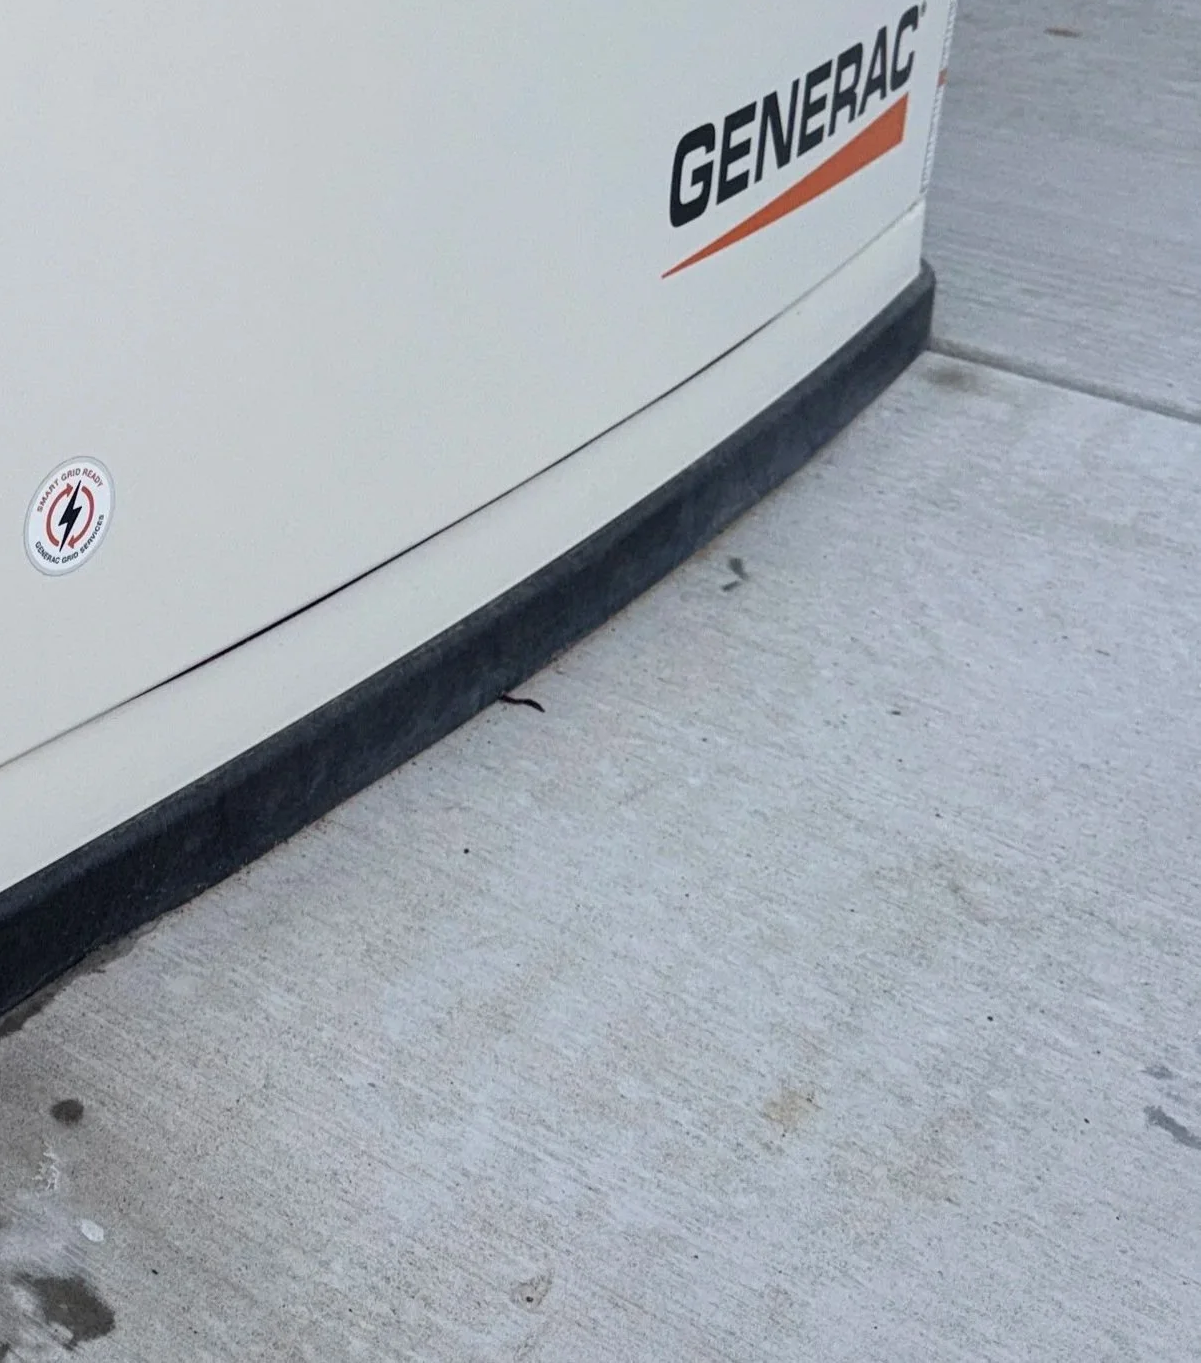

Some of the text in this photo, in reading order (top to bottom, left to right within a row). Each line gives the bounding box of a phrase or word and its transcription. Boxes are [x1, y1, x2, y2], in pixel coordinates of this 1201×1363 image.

[669, 4, 919, 228] GENERAC
[37, 467, 103, 512] SMART GRID READY
[35, 514, 104, 564] GENERAC GRID SERVICES
